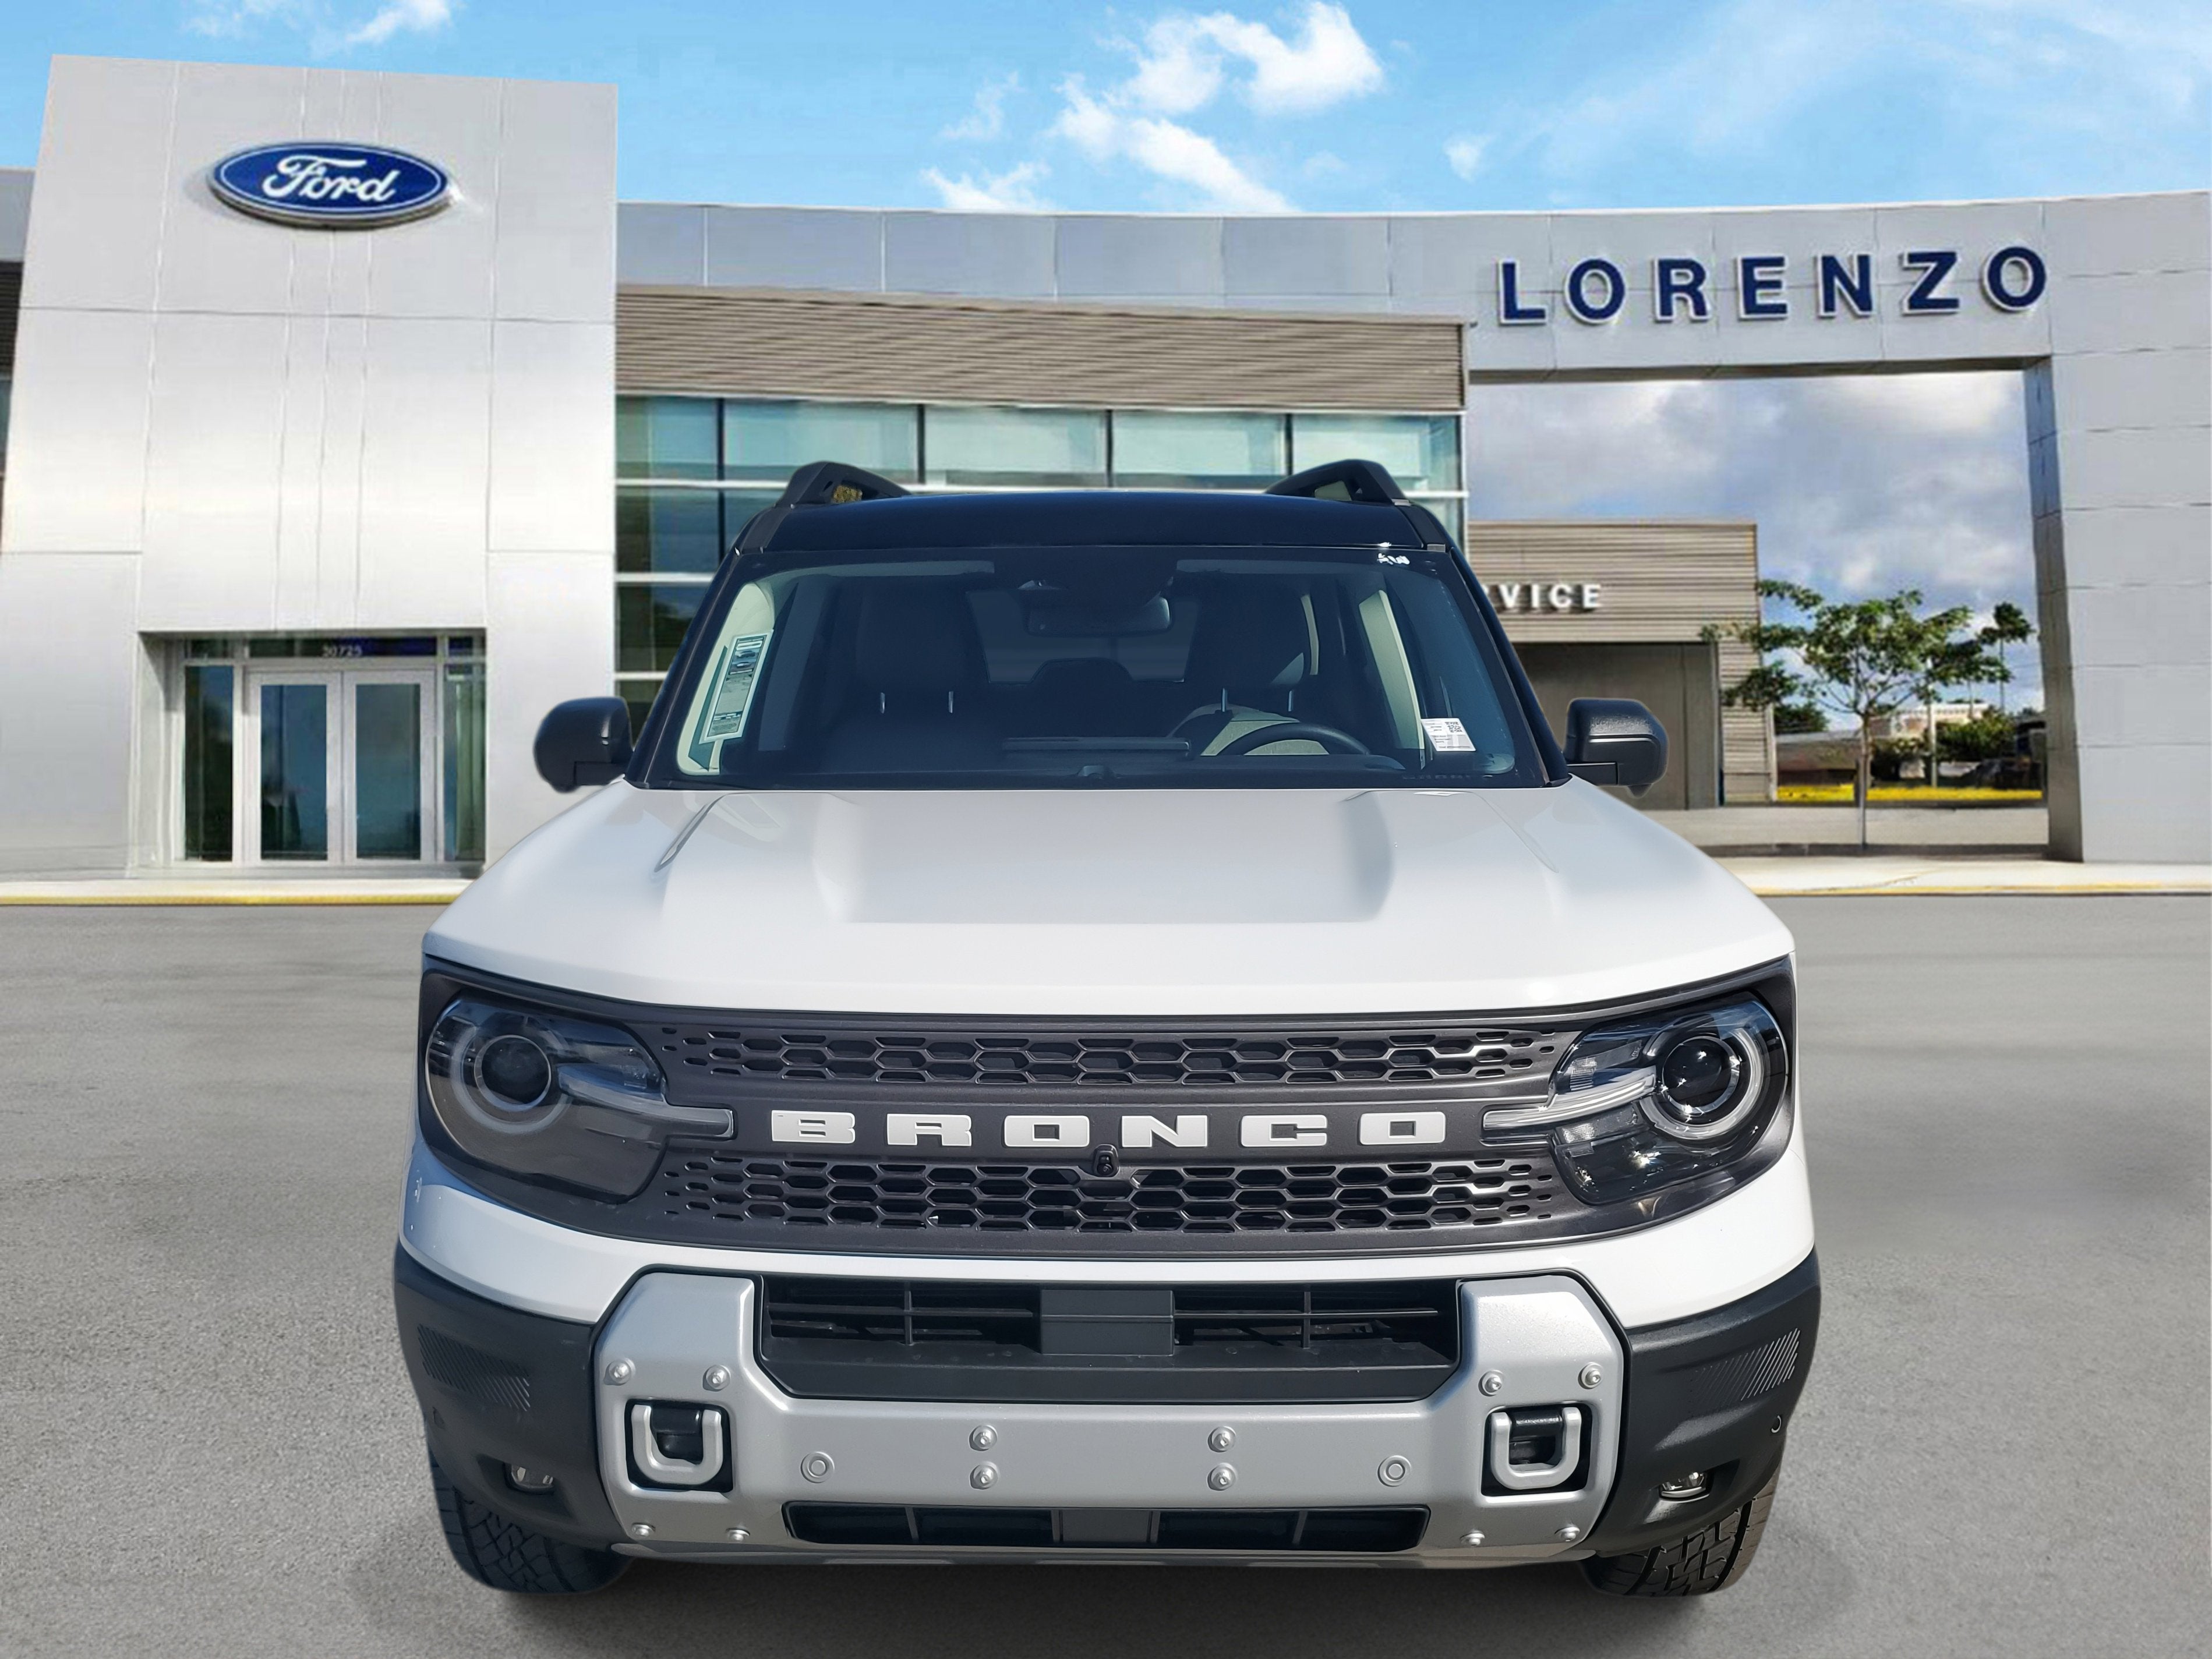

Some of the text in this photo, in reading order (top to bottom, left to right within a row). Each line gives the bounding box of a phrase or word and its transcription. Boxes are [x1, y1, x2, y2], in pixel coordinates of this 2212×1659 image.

[262, 154, 400, 201] Ford
[1499, 246, 2047, 325] LORENZO
[771, 1109, 1447, 1148] BRONCO
